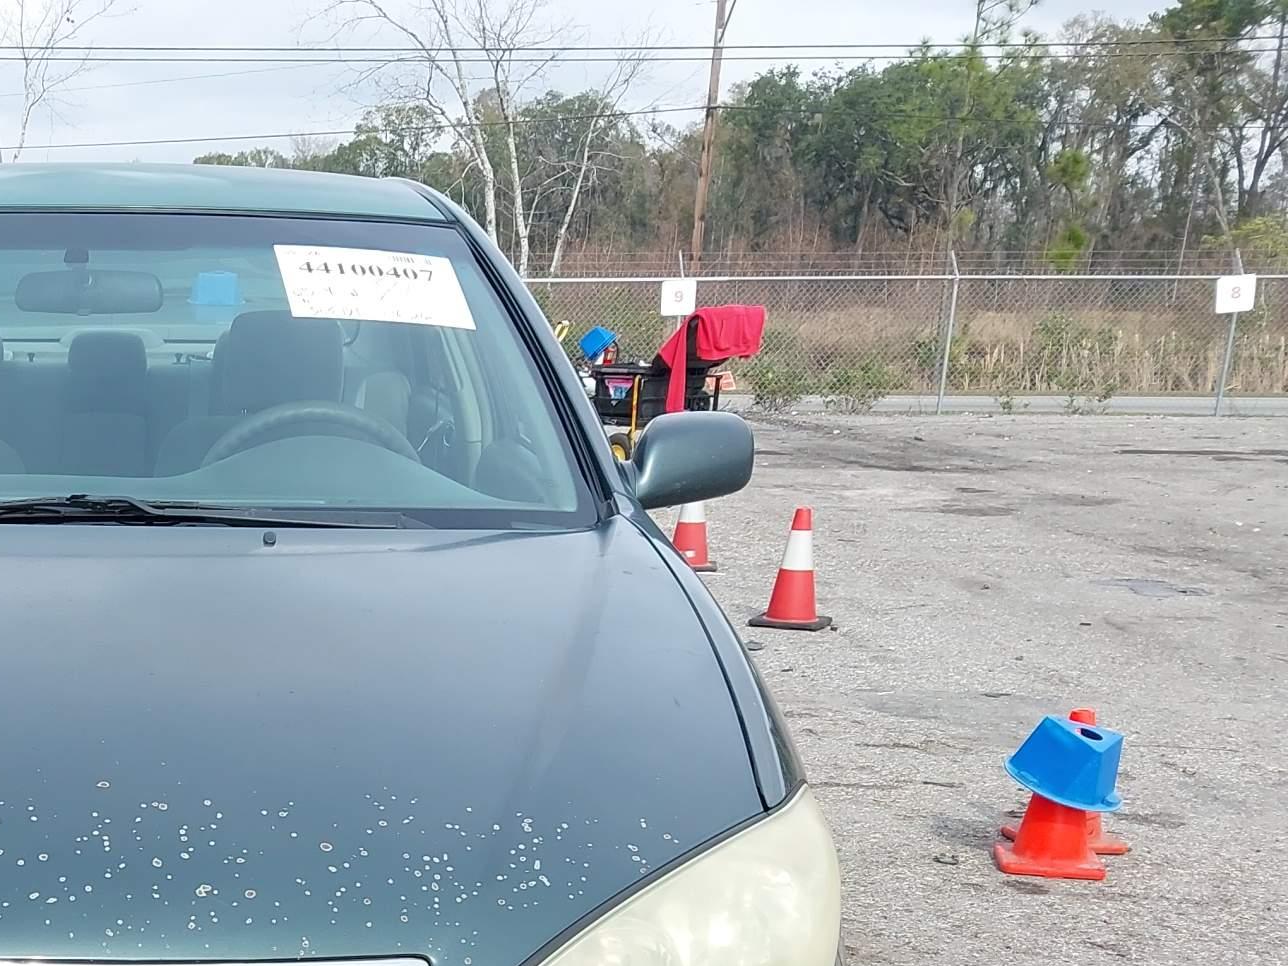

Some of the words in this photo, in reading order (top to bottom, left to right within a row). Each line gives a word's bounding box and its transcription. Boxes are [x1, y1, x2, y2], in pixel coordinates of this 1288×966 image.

[298, 261, 433, 282] 44100407
[673, 290, 684, 303] 9
[1230, 286, 1241, 299] 8
